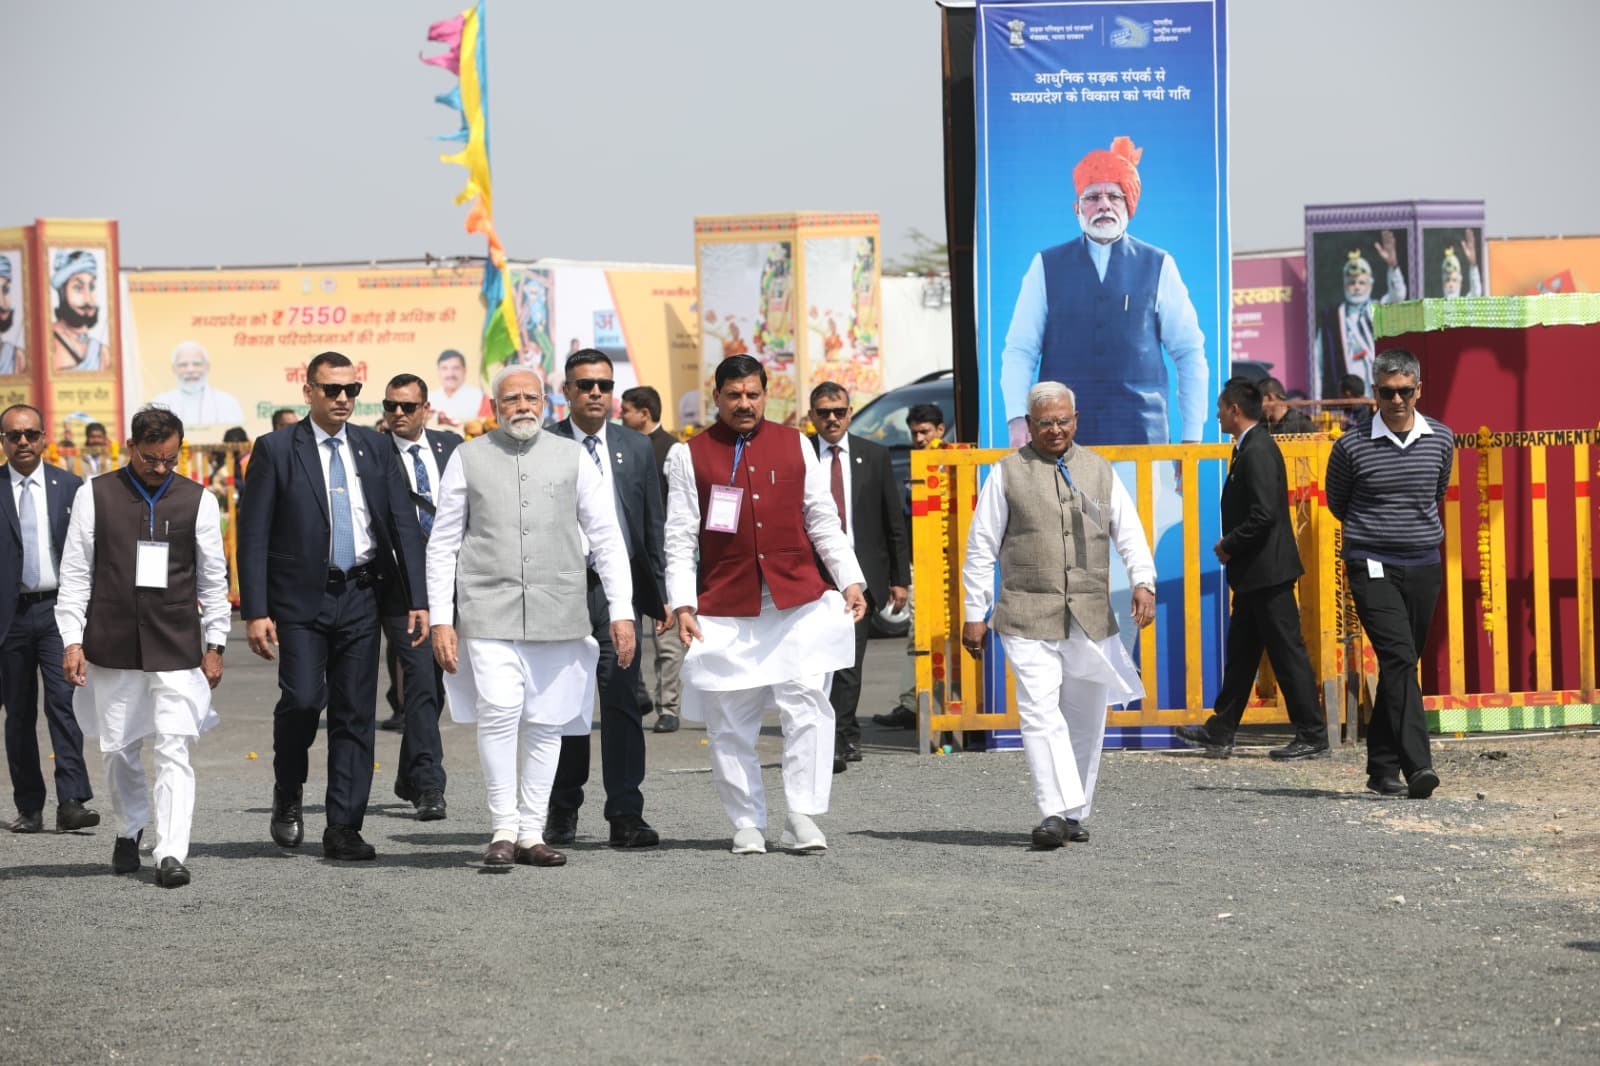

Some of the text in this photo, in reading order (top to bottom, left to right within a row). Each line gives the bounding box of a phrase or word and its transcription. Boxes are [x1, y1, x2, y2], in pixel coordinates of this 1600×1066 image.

[1034, 67, 1166, 88] आधुनिक सड़क संपर्क से
[1010, 85, 1191, 105] मध्यप्रदेश के विकास को नयी गति
[1231, 286, 1292, 305] रस्कार
[1504, 429, 1591, 447] DEPARTMENT
